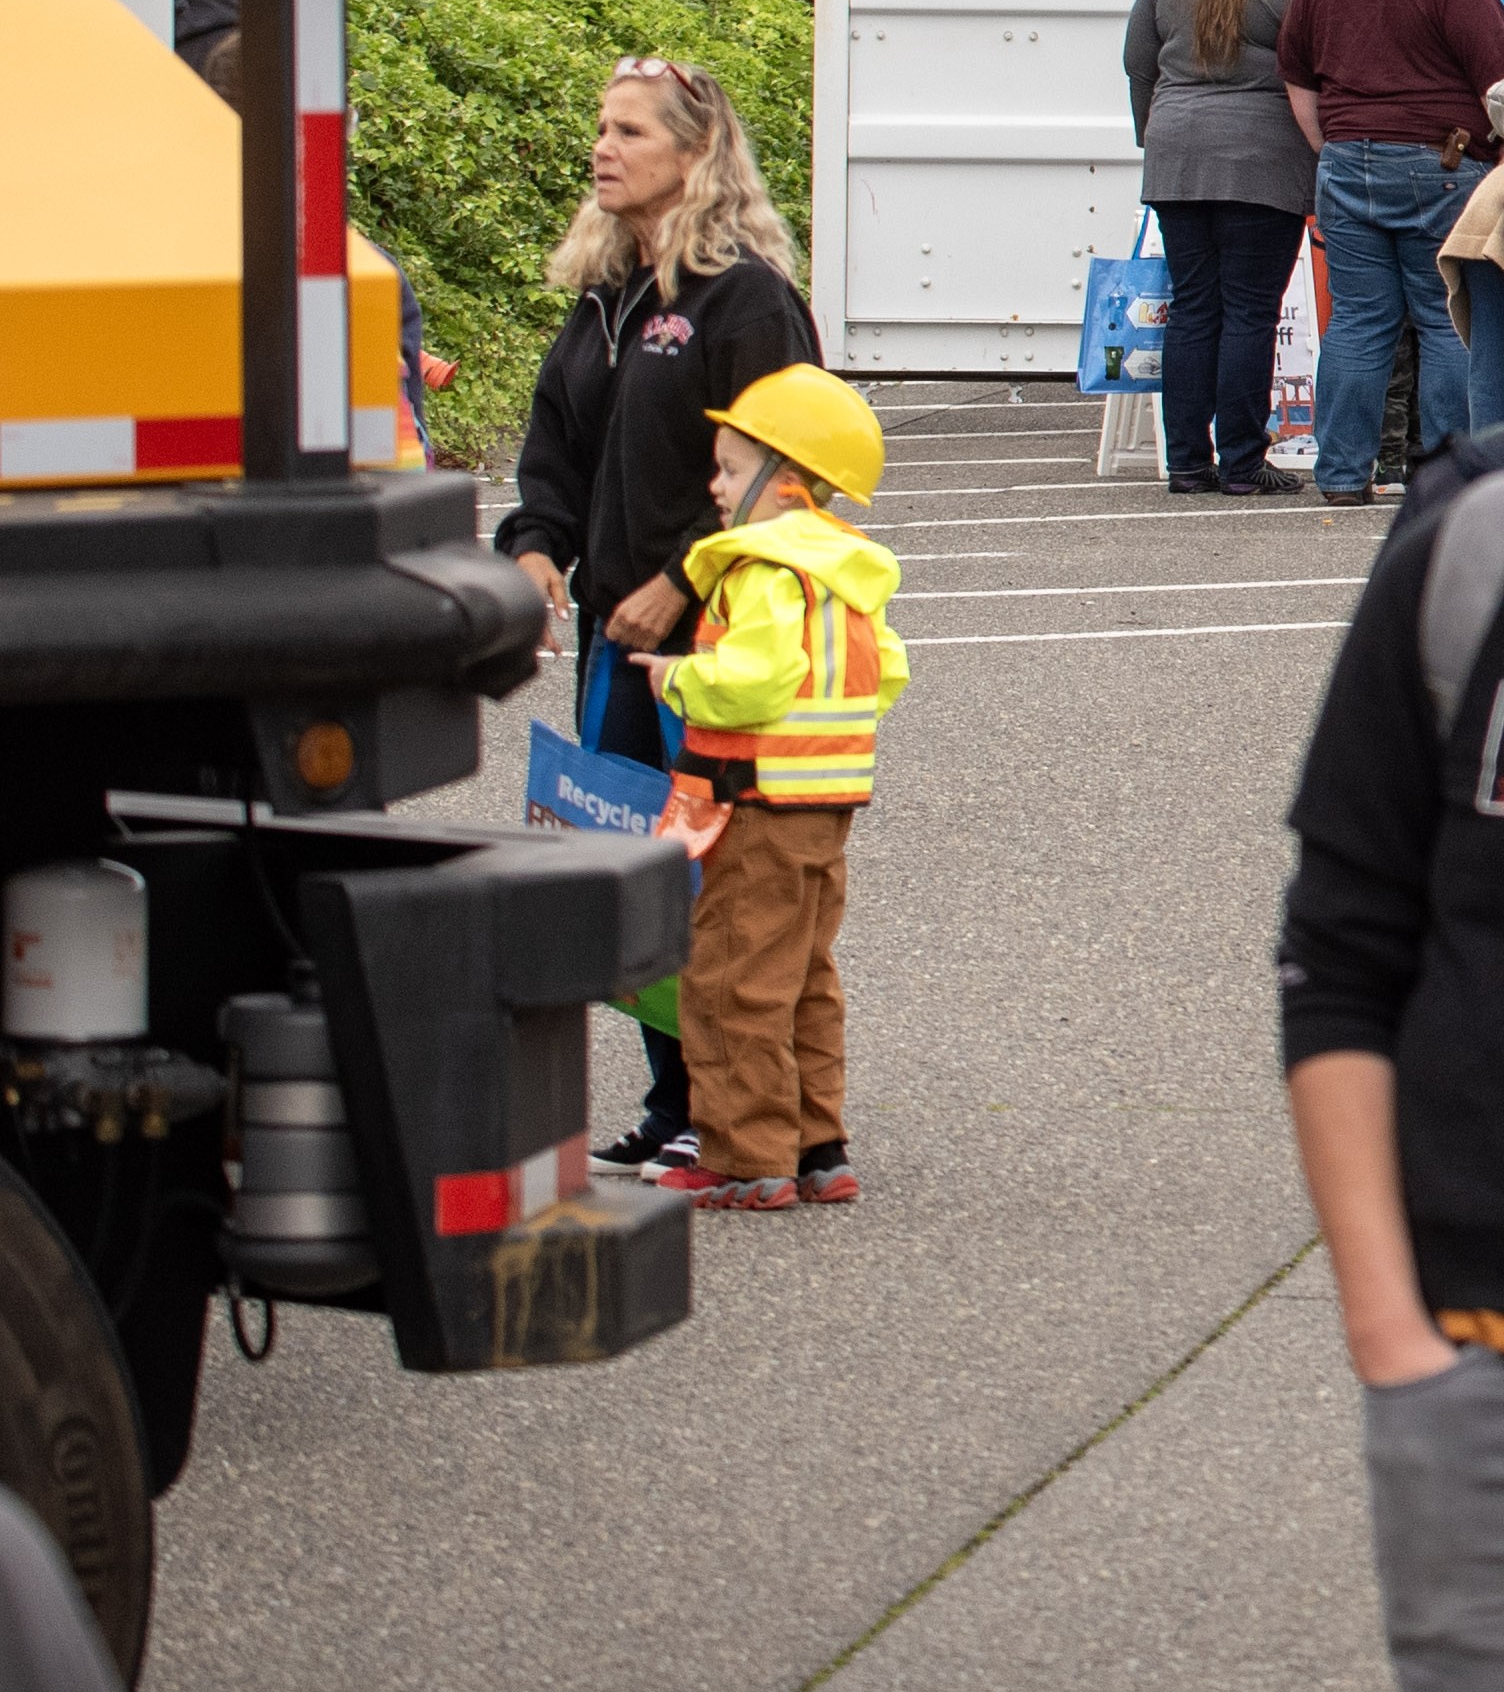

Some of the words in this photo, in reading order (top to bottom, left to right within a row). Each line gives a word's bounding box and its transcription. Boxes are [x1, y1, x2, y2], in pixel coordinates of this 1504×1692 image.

[1279, 306, 1299, 321] ur
[1277, 326, 1294, 346] ff
[556, 772, 648, 838] Recycle
